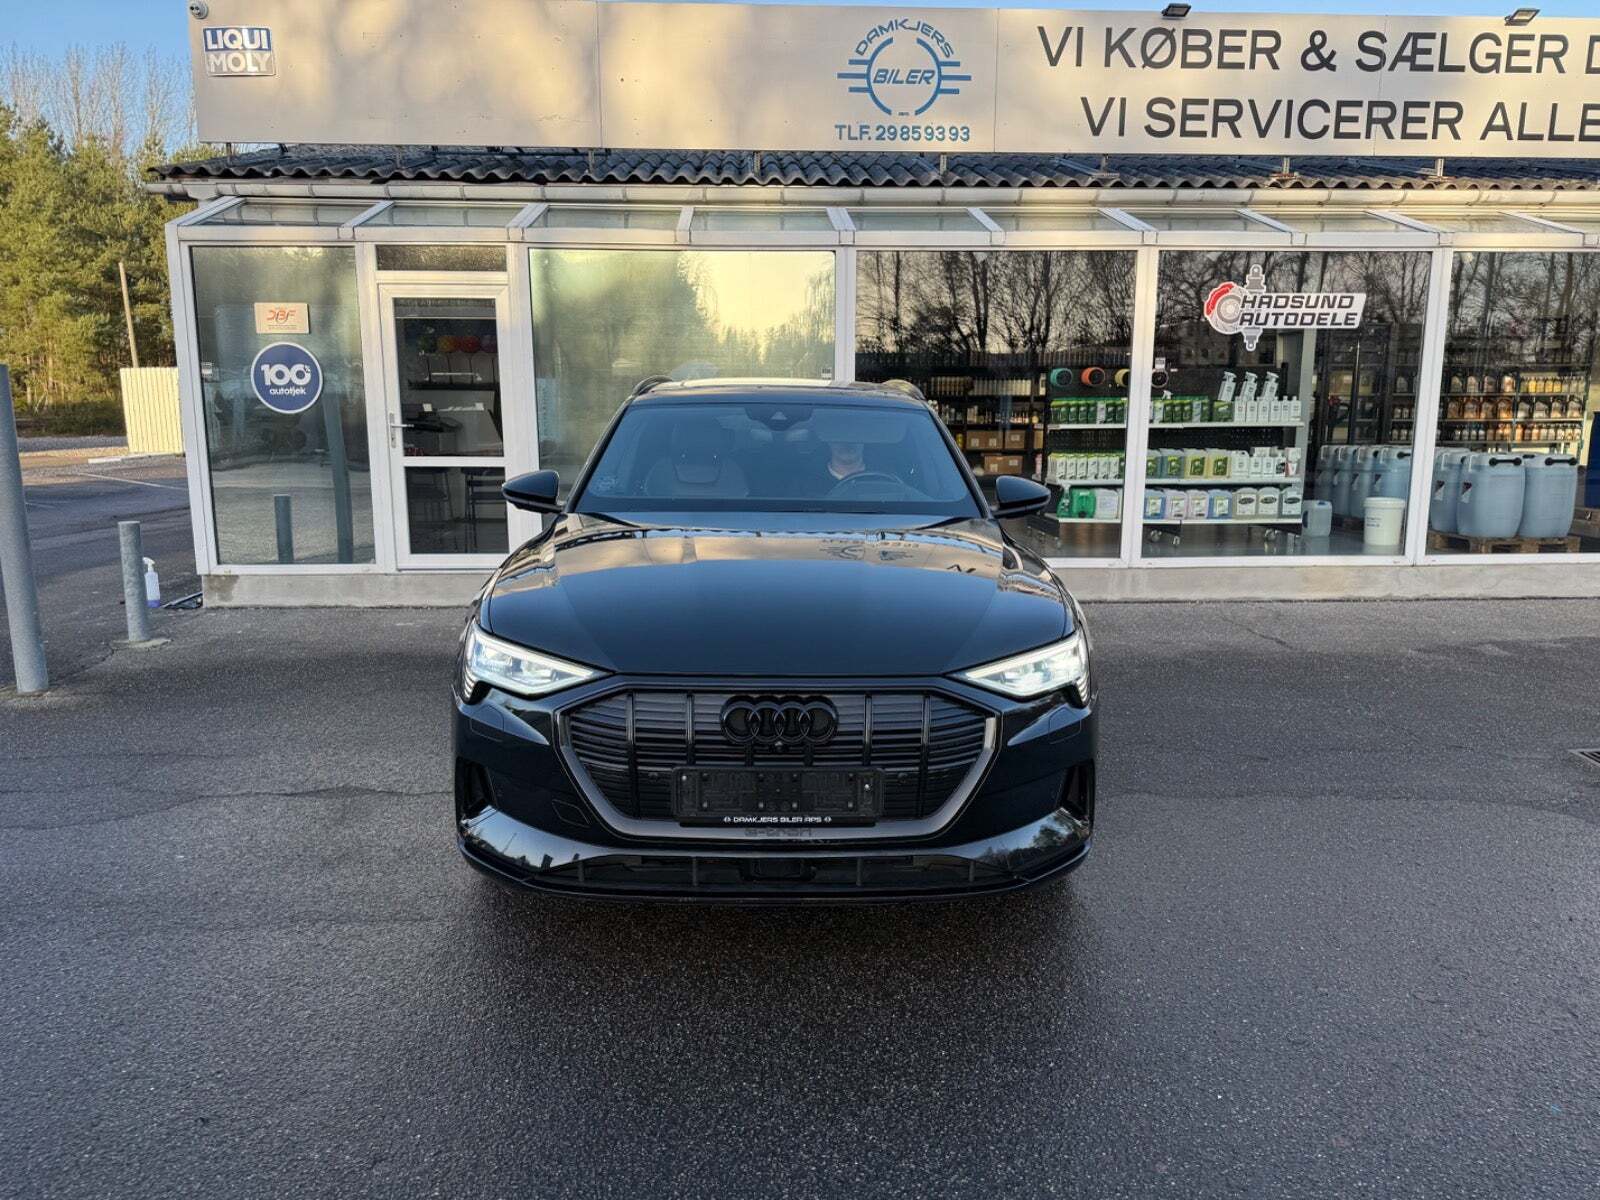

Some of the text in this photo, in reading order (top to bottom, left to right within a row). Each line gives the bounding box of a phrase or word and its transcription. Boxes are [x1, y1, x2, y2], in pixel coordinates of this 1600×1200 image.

[205, 29, 269, 50] LIQUI
[855, 18, 954, 58] DAMKJERS
[1037, 26, 1084, 67] VI
[1104, 27, 1281, 70] KØBER
[1300, 29, 1337, 73] &
[1355, 30, 1569, 74] SÆLGER
[208, 51, 271, 73] MOLY
[873, 68, 935, 84] BILER
[1080, 96, 1127, 137] VI
[1143, 96, 1464, 140] SERVICERER
[1240, 294, 1355, 309] HADSUND
[1238, 312, 1358, 327] AUTODELE
[269, 386, 306, 396] autotjek
